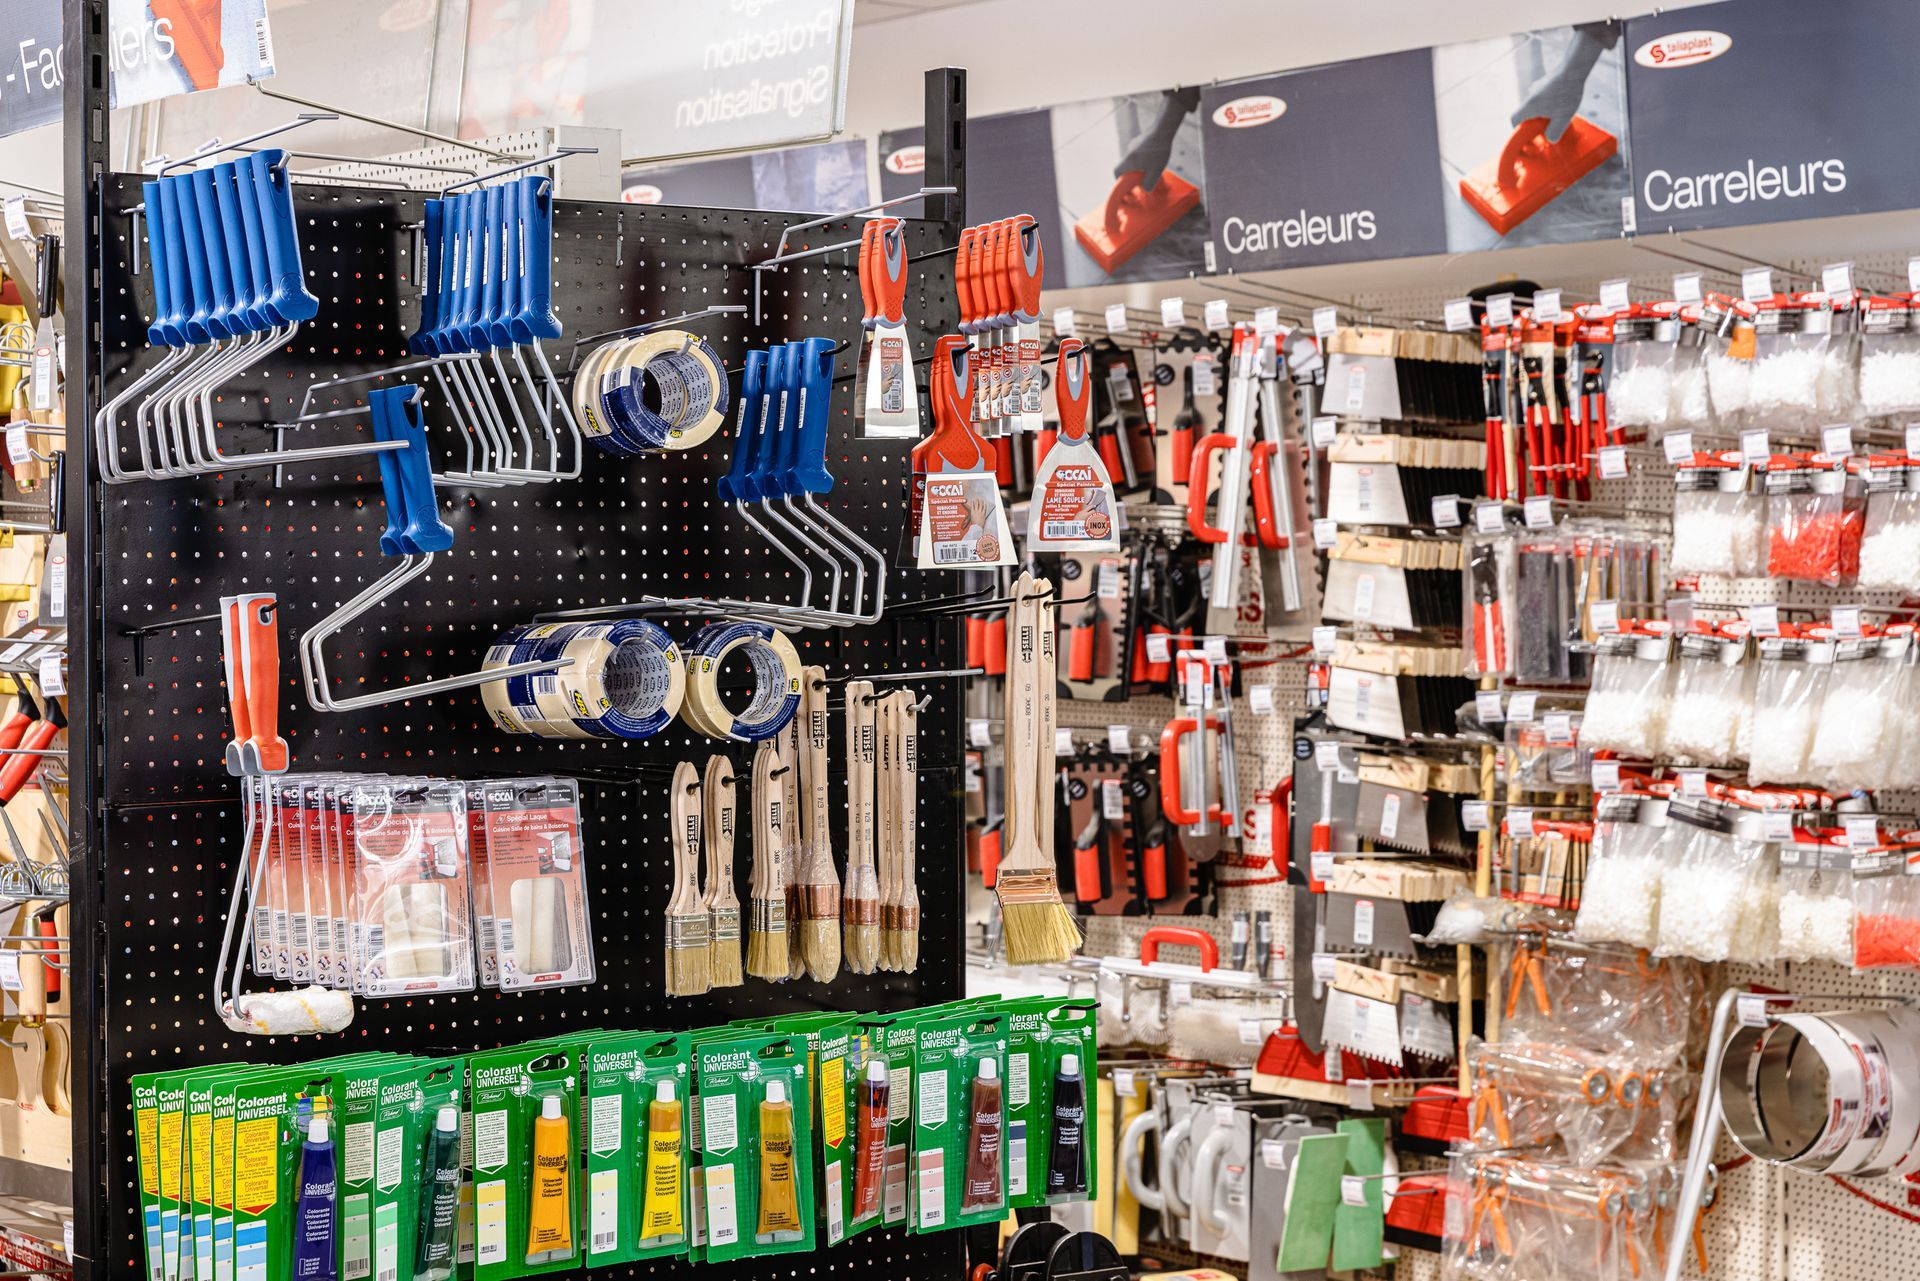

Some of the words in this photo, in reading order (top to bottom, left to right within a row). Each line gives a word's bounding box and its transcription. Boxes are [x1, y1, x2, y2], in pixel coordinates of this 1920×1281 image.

[1644, 159, 1847, 212] Carreleurs
[1223, 209, 1377, 254] Carreleurs
[702, 658, 710, 673] HPX
[574, 690, 589, 717] HPX
[499, 711, 520, 733] HPX
[862, 726, 871, 749] SELLE
[506, 814, 529, 822] Spécial
[1010, 1012, 1044, 1023] lorant
[888, 1028, 915, 1039] Colora
[921, 1027, 962, 1041] Colorant
[822, 1034, 849, 1050] Colorant
[888, 1034, 916, 1047] UNIVERSE
[921, 1037, 958, 1049] UNIVERSEL
[593, 1050, 638, 1064] Colorant
[704, 1050, 751, 1064] Colorant
[822, 1046, 849, 1061] UNIVERSEL
[476, 1064, 523, 1079] Colorant
[593, 1060, 634, 1073] UNIVERSEL
[704, 1060, 747, 1073] UNIVERSEL
[346, 1078, 378, 1090] olora
[382, 1079, 419, 1096] Colorant
[476, 1074, 519, 1089] UNIVERSEL
[346, 1086, 377, 1099] NIVERS
[381, 1090, 415, 1106] UNIVERSEL
[238, 1092, 288, 1110] Colorant
[237, 1104, 288, 1121] UNIVERSEL
[1056, 1105, 1082, 1113] Colorant
[244, 1136, 271, 1145] Universale
[245, 1130, 269, 1140] Colorante
[654, 1139, 680, 1147] Colorant
[244, 1156, 268, 1164] Colorante
[244, 1160, 268, 1169] Universal
[538, 1155, 566, 1163] Colorant
[244, 1180, 269, 1188] Colorante
[244, 1184, 269, 1193] Universal
[306, 1180, 335, 1190] Colorant
[305, 1187, 334, 1196] UNIVERSEL
[307, 1218, 330, 1226] Colorante
